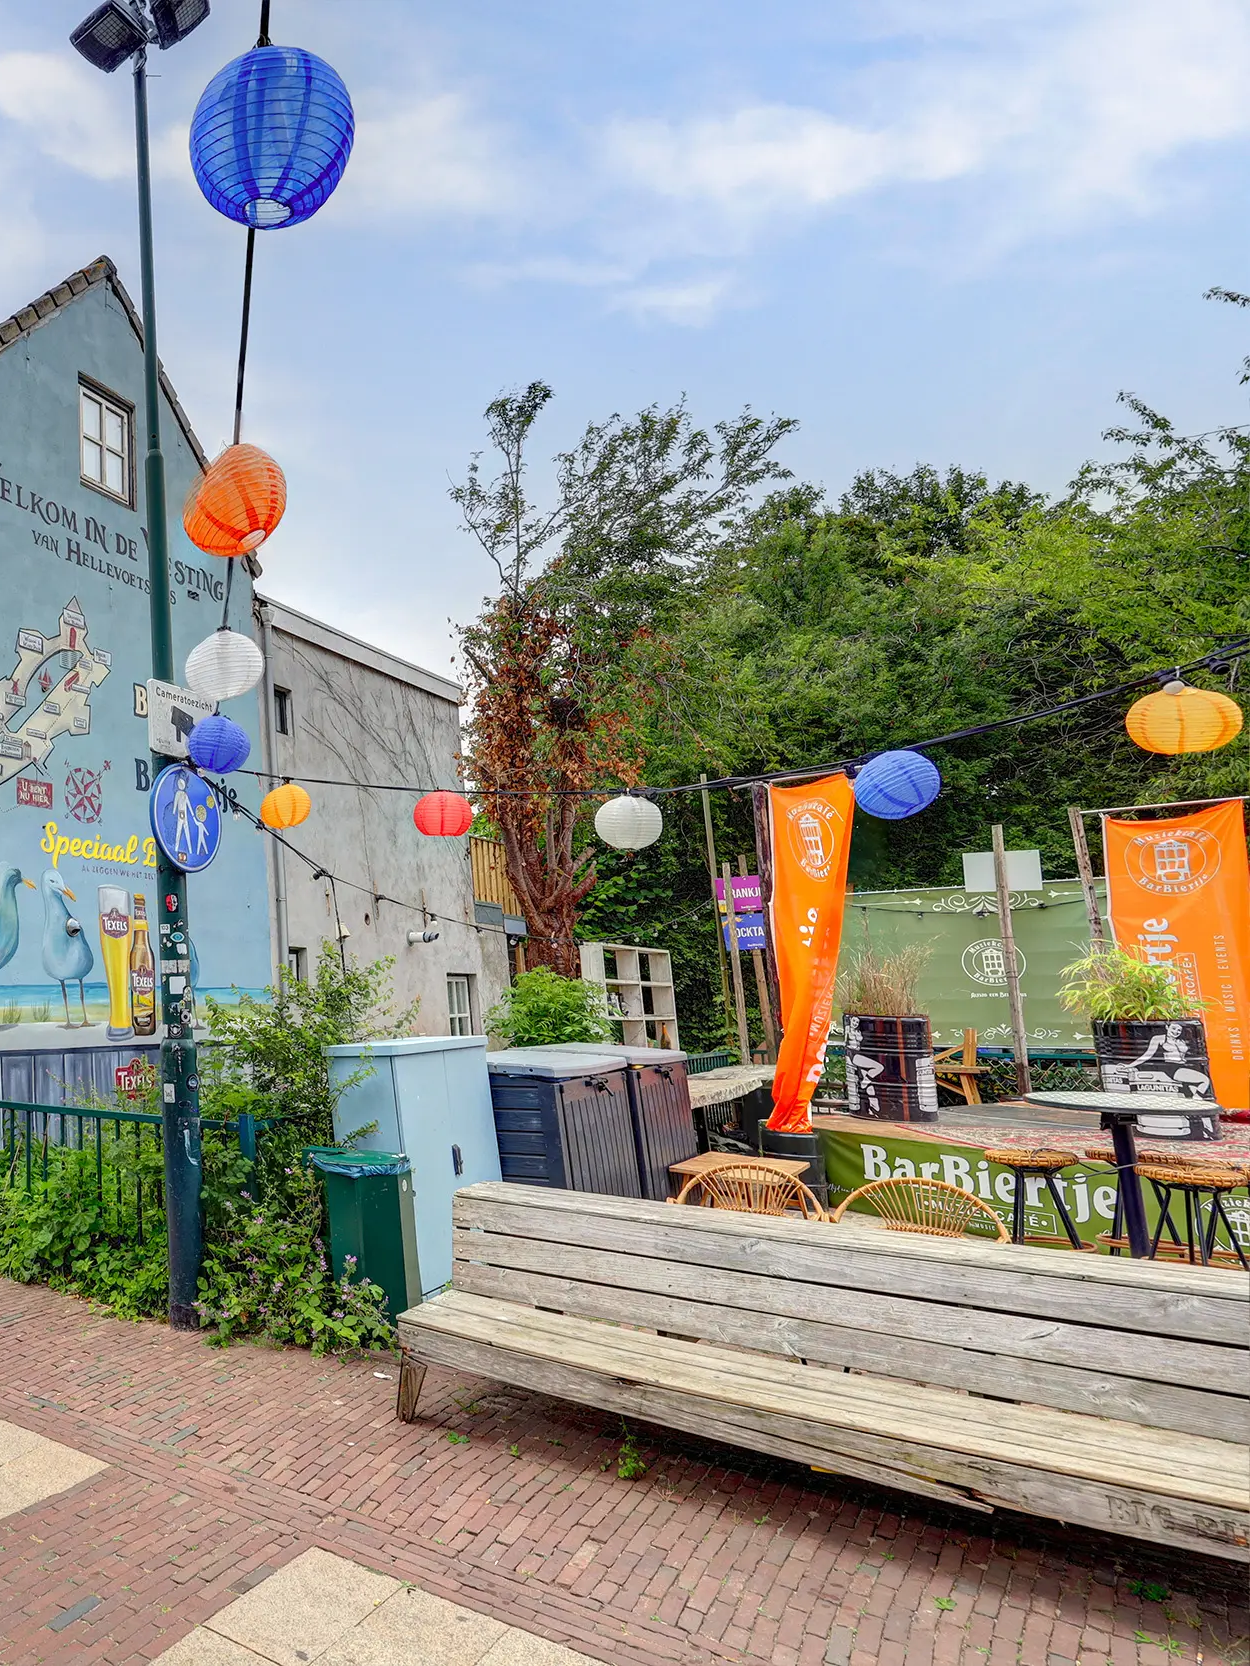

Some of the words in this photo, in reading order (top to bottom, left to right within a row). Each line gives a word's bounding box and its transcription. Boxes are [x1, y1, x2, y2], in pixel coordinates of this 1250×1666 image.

[31, 530, 61, 560] VAN
[65, 537, 177, 605] HELLEVOETSS
[84, 516, 108, 554] IN
[116, 533, 138, 562] DE
[140, 526, 224, 603] STING
[155, 686, 213, 712] Cameratoezicht
[40, 821, 139, 869] Speciaal
[102, 917, 128, 931] TEXELS
[1213, 934, 1230, 970] EVENTS
[131, 973, 154, 988] TEXELS
[1222, 983, 1237, 1013] MUSIC
[1227, 1026, 1244, 1061] DRINKS
[1136, 1084, 1179, 1092] LAGUNITAS
